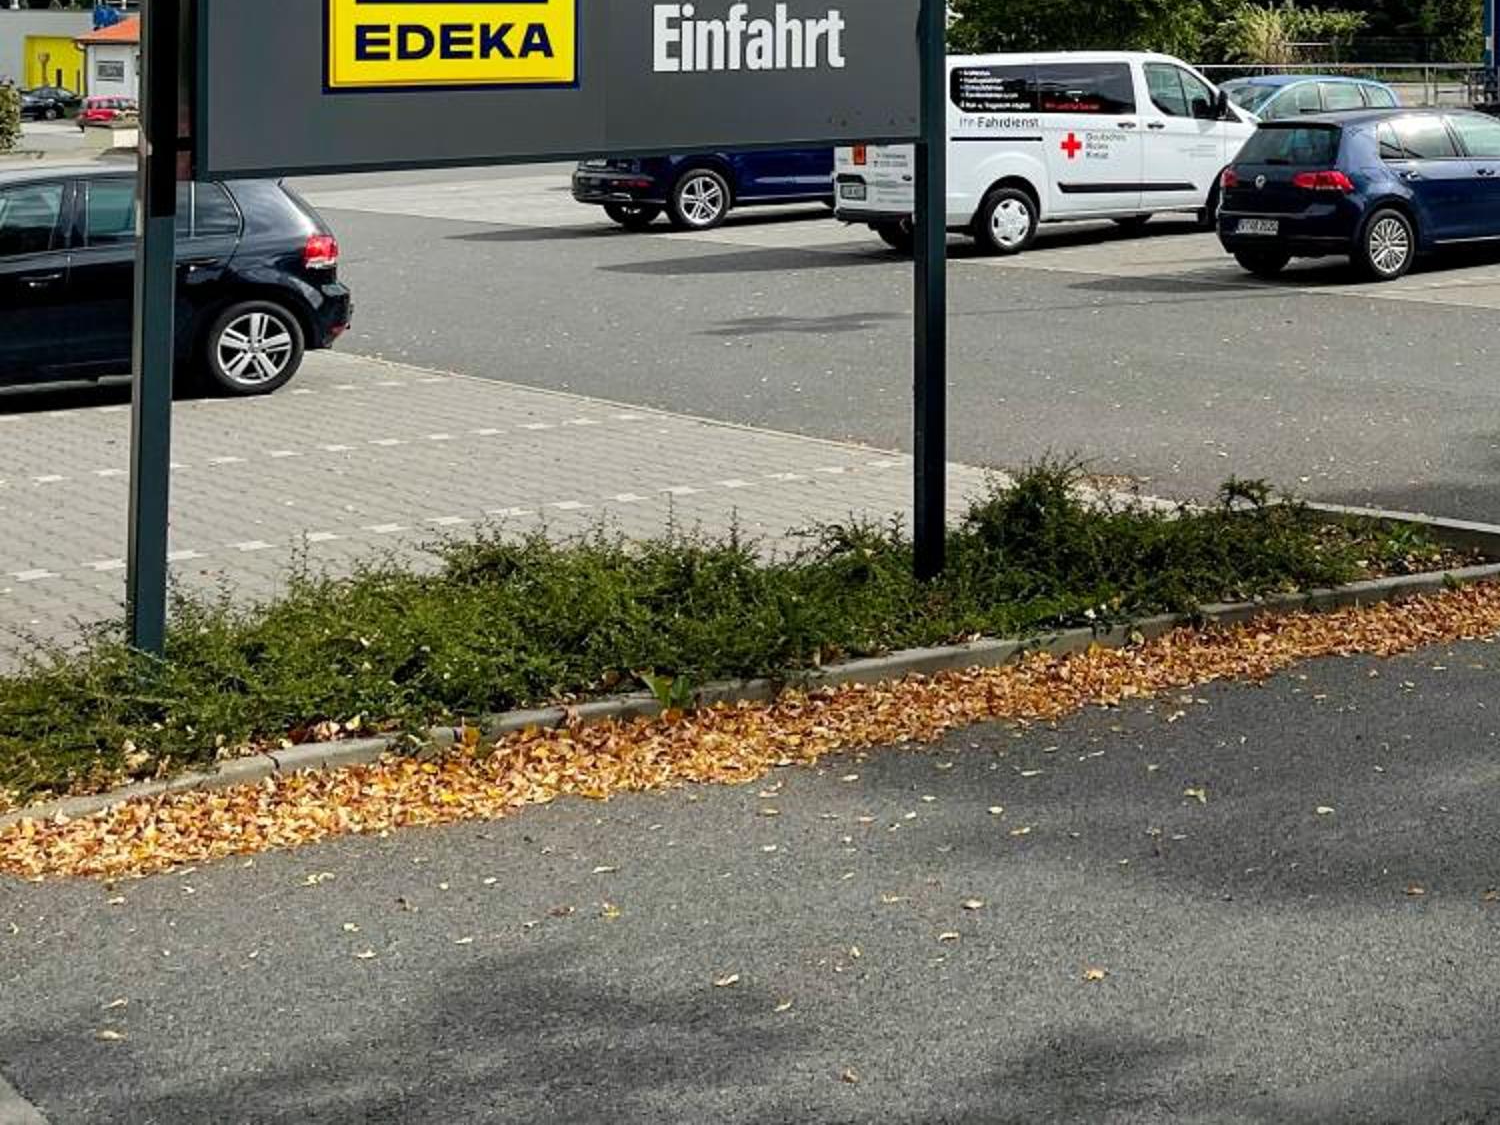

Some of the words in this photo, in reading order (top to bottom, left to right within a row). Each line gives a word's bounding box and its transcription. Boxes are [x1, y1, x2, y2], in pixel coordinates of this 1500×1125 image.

[354, 22, 554, 62] EDEKA
[652, 1, 845, 73] Einfahrt
[977, 115, 1040, 129] Fahrdienst
